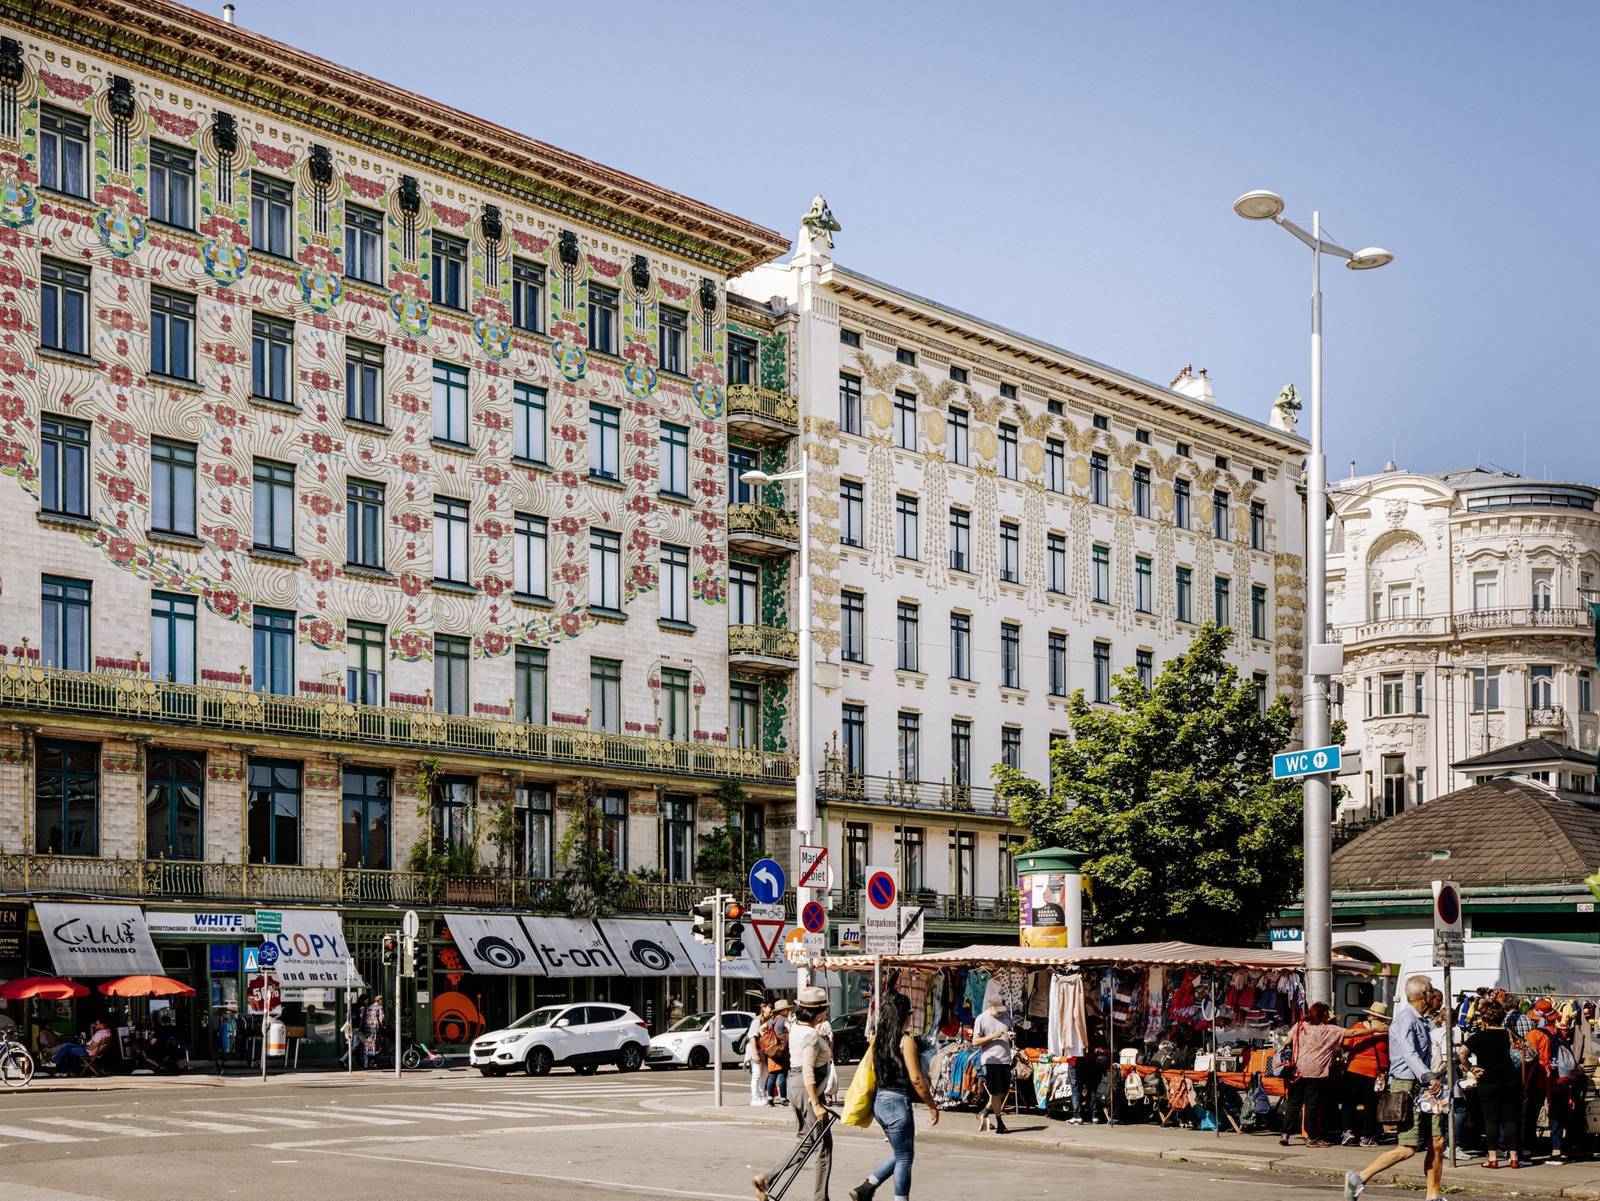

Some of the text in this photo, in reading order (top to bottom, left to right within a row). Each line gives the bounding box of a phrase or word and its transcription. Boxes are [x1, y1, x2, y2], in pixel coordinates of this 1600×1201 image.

[1286, 755, 1308, 773] WC
[801, 851, 826, 865] Mar-
[1584, 904, 1593, 912] 20
[194, 914, 243, 926] WHITE
[866, 917, 897, 928] Kurzparkzone
[843, 928, 859, 940] dm
[1272, 928, 1289, 939] WC
[68, 946, 137, 954] KUISHIMBO
[276, 933, 339, 957] COPY
[540, 944, 613, 967] t-on
[282, 971, 338, 981] und mehr
